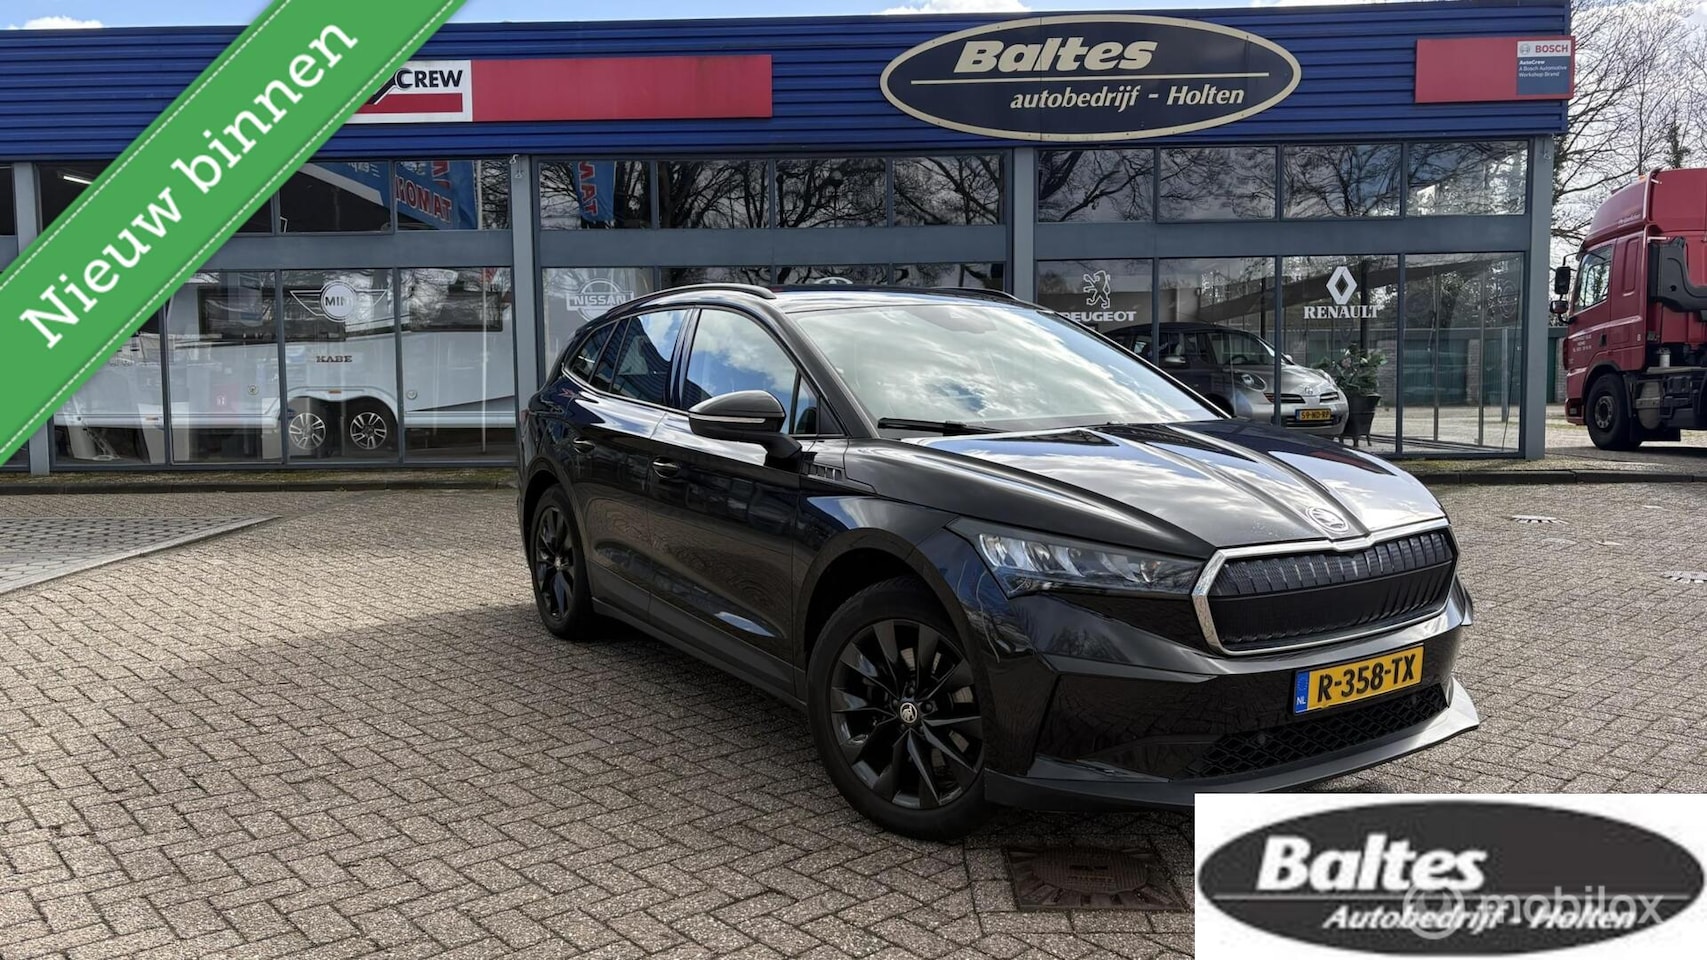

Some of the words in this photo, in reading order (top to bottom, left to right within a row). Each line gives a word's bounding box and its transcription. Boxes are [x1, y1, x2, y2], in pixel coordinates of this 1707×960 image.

[953, 37, 1159, 73] Baltes
[1535, 44, 1568, 53] BOSCH
[1010, 85, 1141, 113] autobedrijf
[1166, 84, 1245, 106] Holten
[574, 295, 627, 306] NISSAN
[1303, 305, 1377, 319] RENAULT
[1317, 653, 1416, 702] R-358-TX
[1296, 696, 1307, 705] NL
